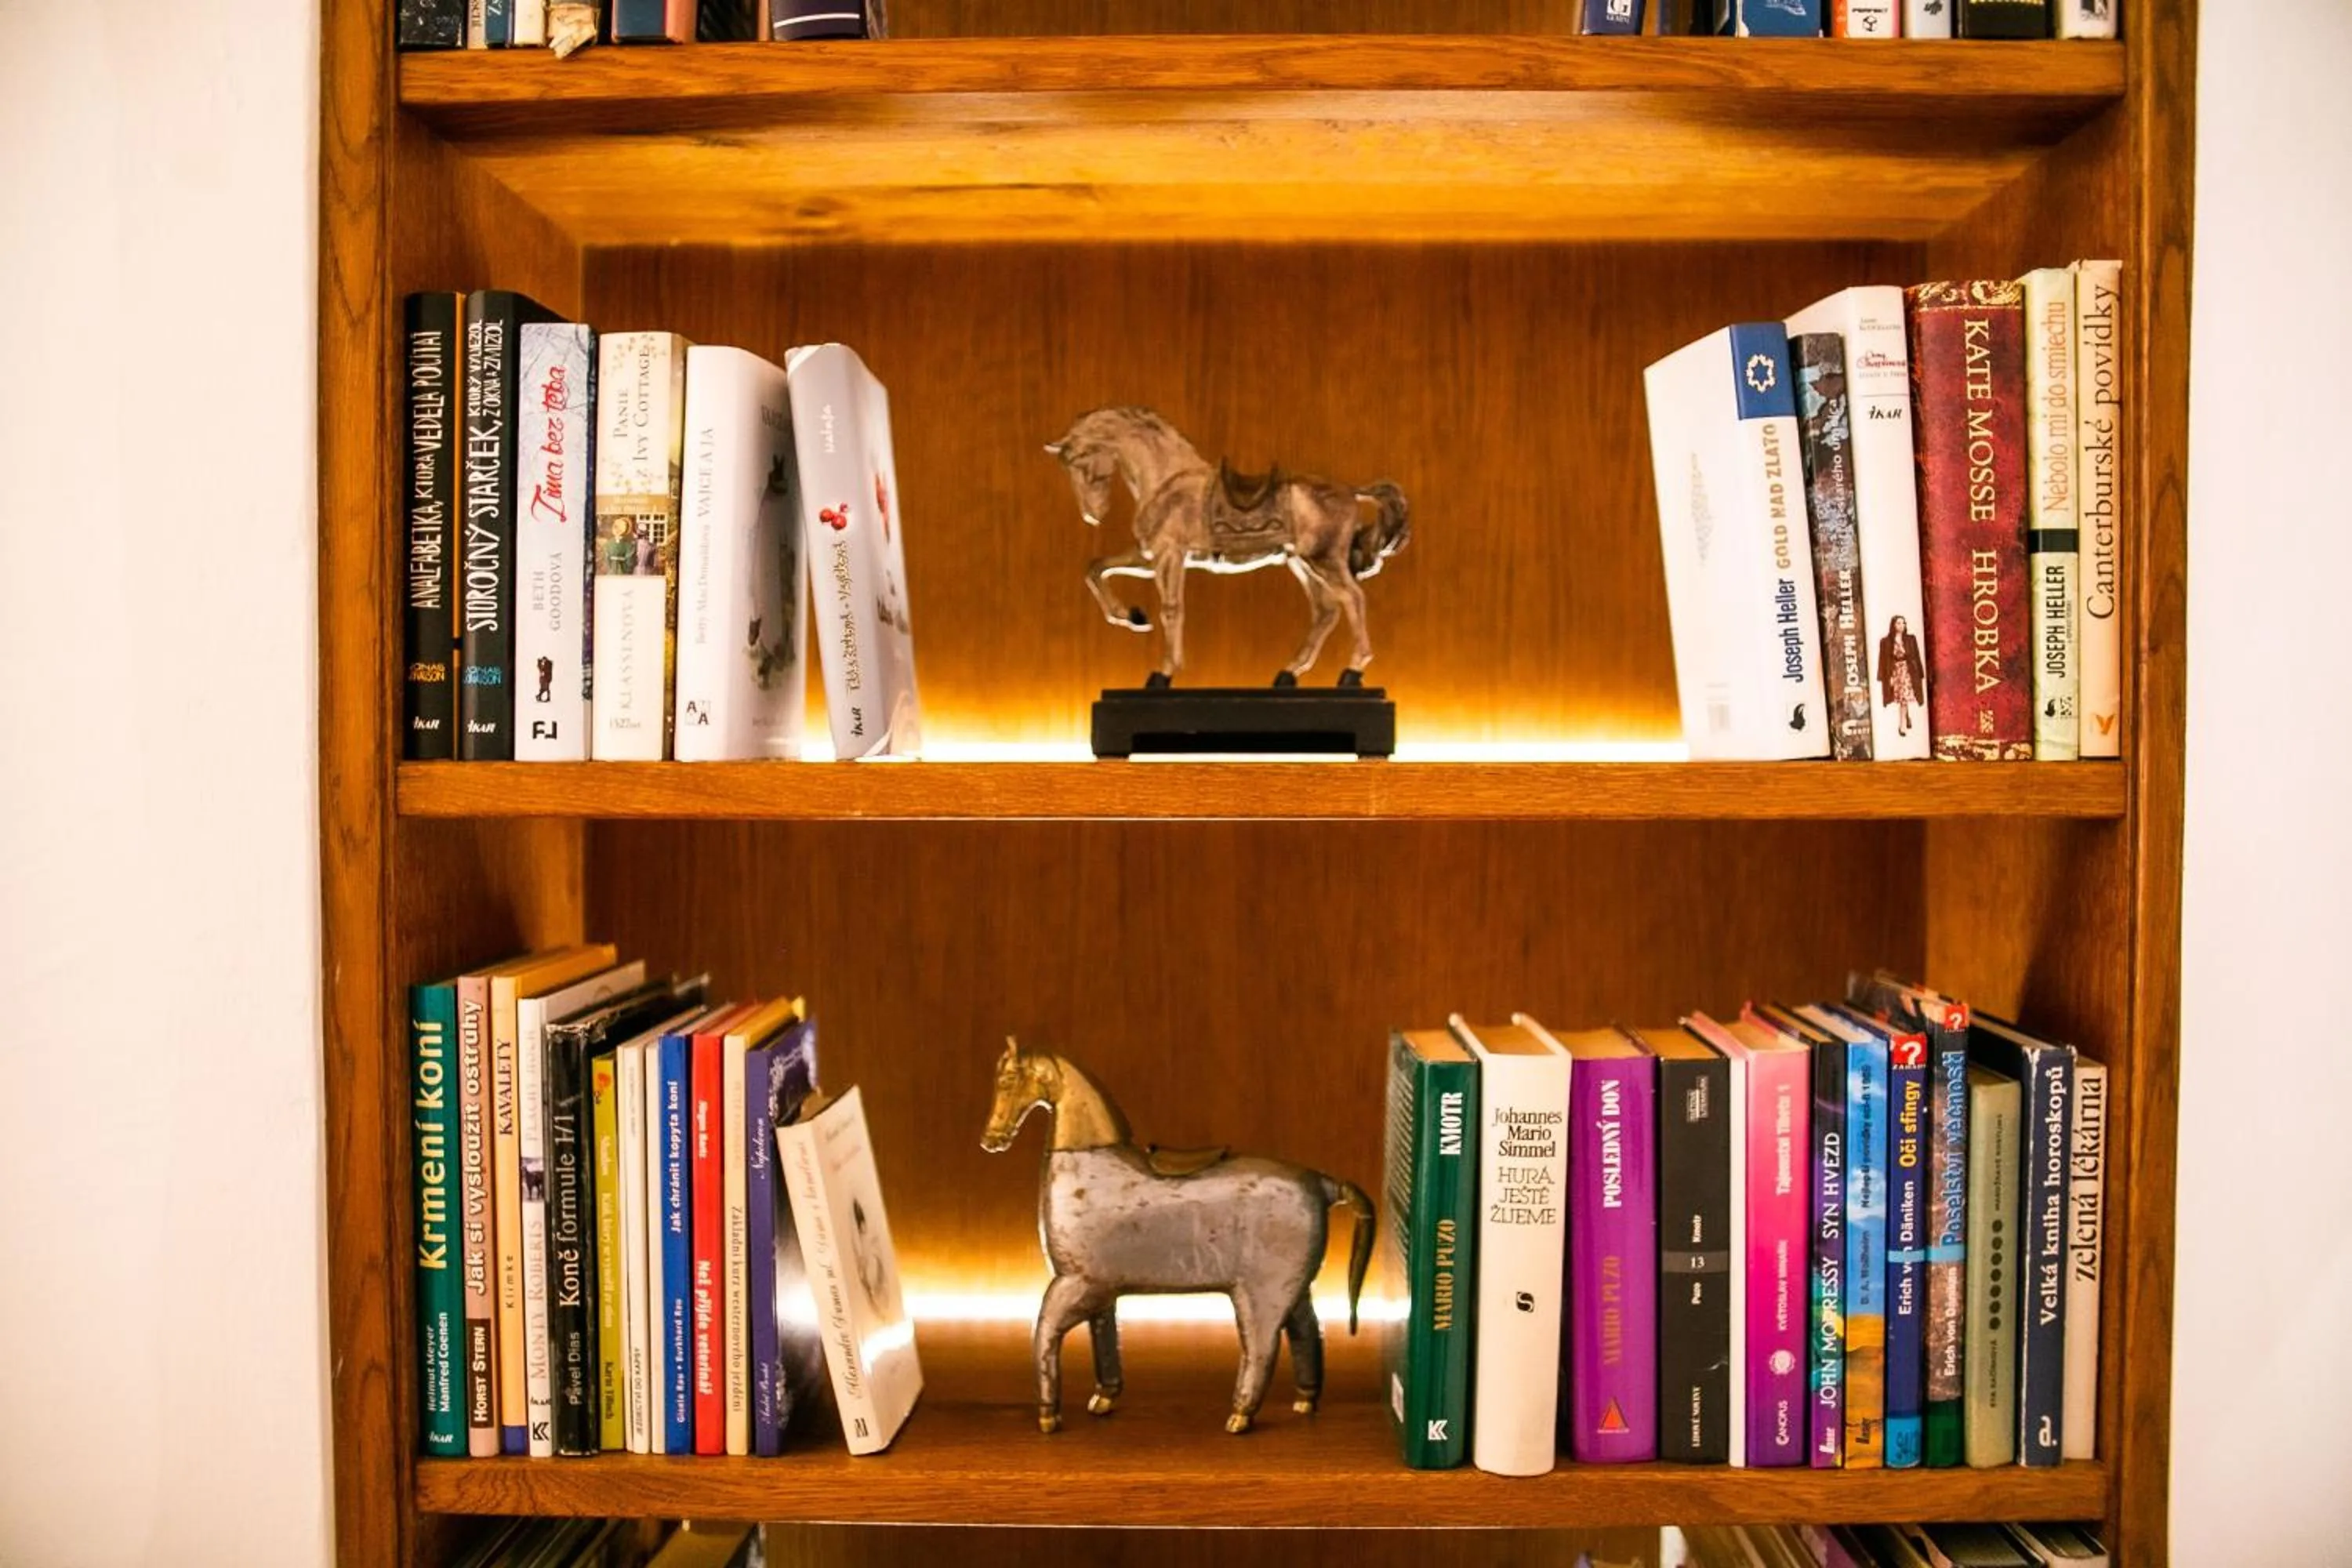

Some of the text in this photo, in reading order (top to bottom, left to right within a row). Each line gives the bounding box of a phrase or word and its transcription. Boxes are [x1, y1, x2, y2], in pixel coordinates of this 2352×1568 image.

[484, 319, 503, 371] ZMIZOL
[412, 392, 445, 453] VEDELA
[484, 377, 501, 407] OKNA
[1964, 318, 1995, 521] KATE MOSSE
[2041, 302, 2069, 513] Nebolo mi do smiechu
[531, 366, 567, 523] Zima bez teba
[2083, 284, 2120, 619] Canterburské povídky
[464, 419, 503, 630] STOROČNÝ STARČEK,
[1762, 423, 1792, 569] GOLD NAD ZLATO
[532, 570, 545, 611] BETH
[1775, 579, 1804, 683] Joseph Heller
[1838, 570, 1863, 693] JOSEPH HELLER
[1972, 549, 2001, 695] HROBKA
[2045, 565, 2066, 677] JOSEPH HELLER
[497, 1039, 513, 1136] KAVALETY
[1438, 1091, 1464, 1155] KMOTR
[1491, 1107, 1562, 1127] Johannes
[1507, 1125, 1552, 1141] Mario
[1897, 1081, 1921, 1133] sfingy
[1940, 1049, 1964, 1144] věčnosti
[413, 1018, 448, 1269] Krmení koní
[462, 998, 486, 1295] Jak si vysloužit ostruhy
[667, 1080, 681, 1233] Jak chránit kopyta koní
[1498, 1140, 1555, 1157] Simmel
[1596, 1080, 1622, 1208] POSLEDNÝ DON
[1897, 1138, 1918, 1167] Oči
[2072, 1077, 2101, 1281] zelená lékárna
[553, 1153, 578, 1243] formule
[731, 1207, 743, 1258] Základní
[1490, 1204, 1556, 1225] ŽIJEME
[1498, 1185, 1550, 1204] JEŠTĚ
[1822, 1203, 1838, 1239] SYN
[1939, 1151, 1965, 1246] Poselství
[2039, 1066, 2067, 1325] Velká kniha horoskopů
[505, 1254, 514, 1308] Klimke
[526, 1221, 544, 1301] ROBERTS
[557, 1249, 580, 1307] Koně
[731, 1261, 743, 1286] kurz
[1433, 1219, 1456, 1330] MARIO PUZO
[1897, 1181, 1915, 1315] Erich Däniken
[530, 1312, 546, 1379] MONTY
[732, 1290, 744, 1368] westernového
[829, 1284, 848, 1329] Dumas
[1602, 1256, 1621, 1366] MARIO PUZO
[1821, 1257, 1838, 1351] MORRESSY
[1942, 1268, 1958, 1376] Erich von Däniken
[437, 1312, 450, 1412] Manfred Coenen
[472, 1327, 488, 1421] HORST STERN
[568, 1367, 583, 1405] Pavel
[840, 1331, 863, 1399] Alexandre
[1820, 1359, 1839, 1409] JOHN
[1776, 1400, 1790, 1446] CANOPUS
